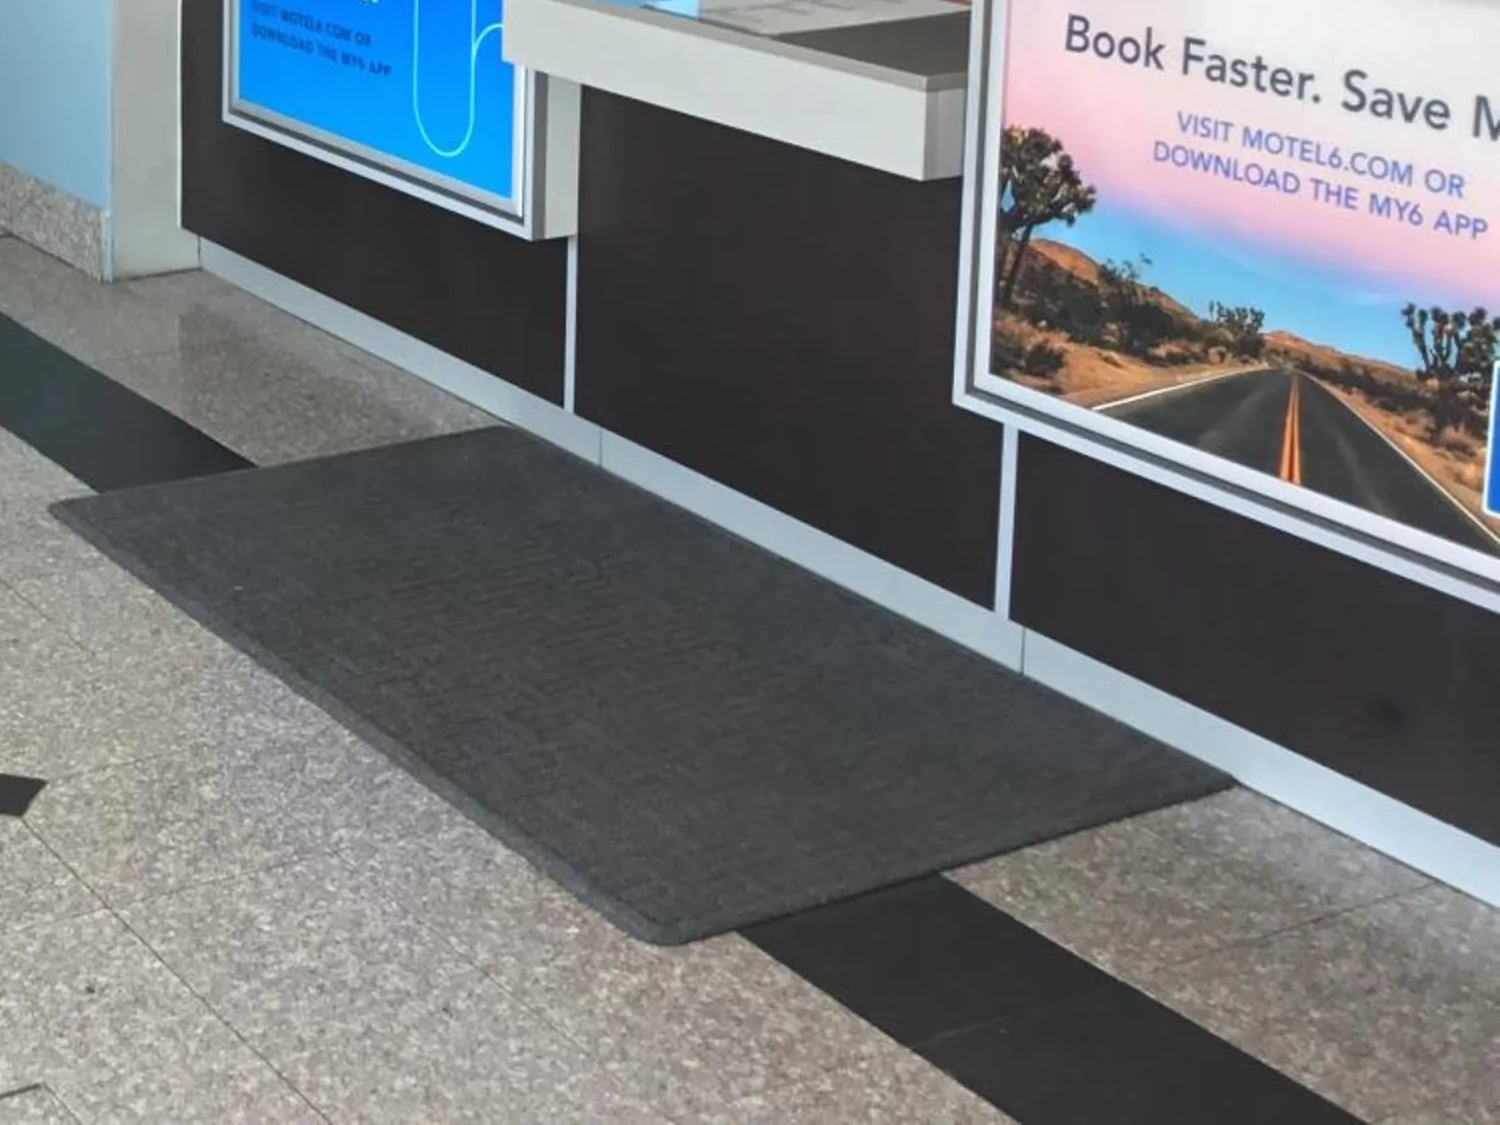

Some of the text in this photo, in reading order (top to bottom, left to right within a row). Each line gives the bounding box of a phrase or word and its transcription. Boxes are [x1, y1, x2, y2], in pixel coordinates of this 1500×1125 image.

[251, 1, 277, 15] VISIT
[355, 30, 371, 47] OR
[251, 21, 314, 54] DOWNLOAD
[317, 42, 338, 63] THE
[369, 61, 392, 76] APP
[1065, 13, 1166, 72] Book
[1182, 37, 1321, 104] Faster.
[1341, 68, 1450, 130] Save
[1153, 140, 1489, 240] DOWNLOAD THE MY6 APP
[1177, 111, 1465, 199] VISIT MOTEL6.COM OR
